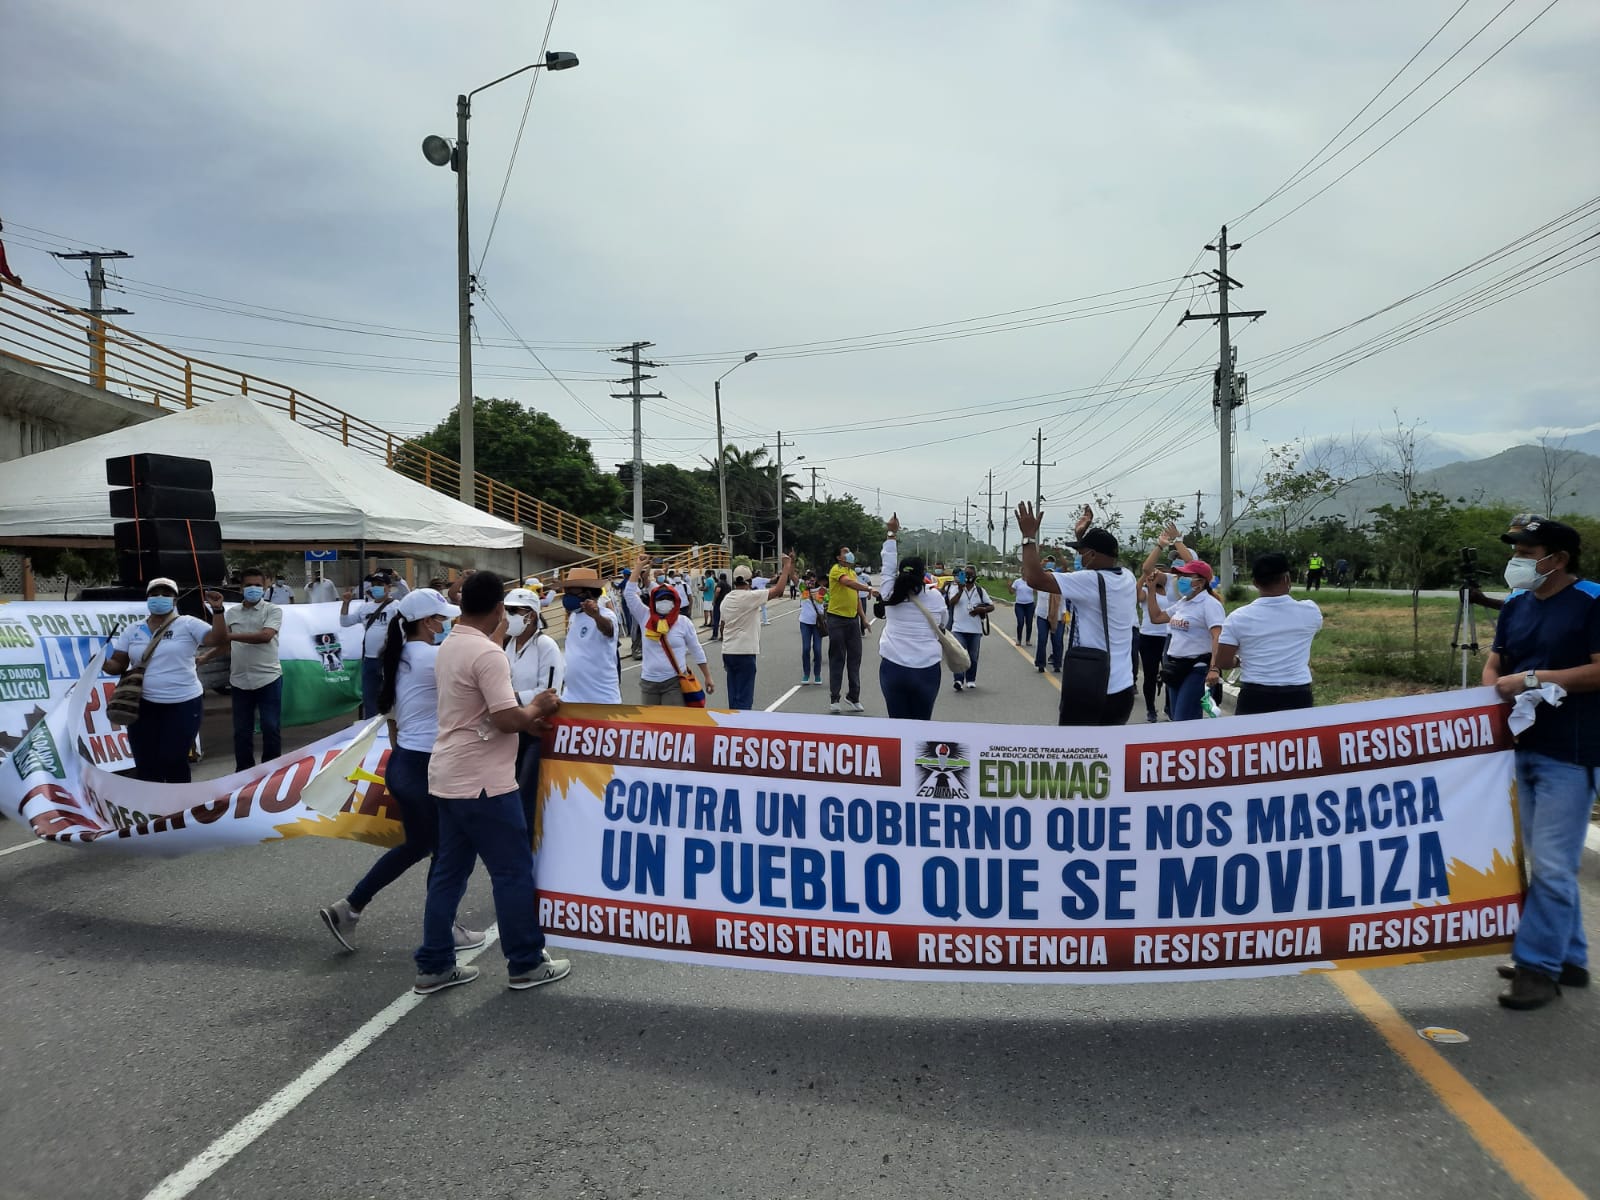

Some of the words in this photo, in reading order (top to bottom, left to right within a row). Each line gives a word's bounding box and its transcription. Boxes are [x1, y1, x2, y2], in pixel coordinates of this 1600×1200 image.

[27, 614, 74, 636] POR
[72, 614, 98, 636] EL
[8, 668, 41, 680] DANDO
[44, 638, 71, 679] A
[1, 682, 49, 699] LUCHA
[553, 725, 696, 764] RESISTENCIA
[712, 735, 882, 778] RESISTENCIA
[989, 745, 1027, 753] SINDICATO
[1002, 751, 1045, 759] EDUCACIÓN
[1139, 736, 1323, 784] RESISTENCIA
[1339, 714, 1494, 766] RESISTENCIA
[916, 785, 970, 800] EDUMAG
[979, 759, 1111, 800] EDUMAG
[604, 779, 742, 834] CONTRA
[755, 791, 806, 839] UN
[819, 796, 1031, 851] GOBIERNO
[1046, 806, 1131, 854] QUE
[1146, 801, 1233, 851] NOS
[1247, 776, 1444, 845] MASACRA
[601, 829, 666, 897] UN
[683, 837, 901, 915] PUEBLO
[922, 856, 1039, 922] QUE
[1061, 858, 1137, 921] SE
[1157, 831, 1450, 918] MOVILIZA
[538, 897, 692, 945] RESISTENCIA
[715, 918, 893, 961] RESISTENCIA
[918, 932, 1108, 966] RESISTENCIA
[1134, 926, 1322, 965] RESISTENCIA
[1348, 902, 1520, 953] RESISTENCIA
